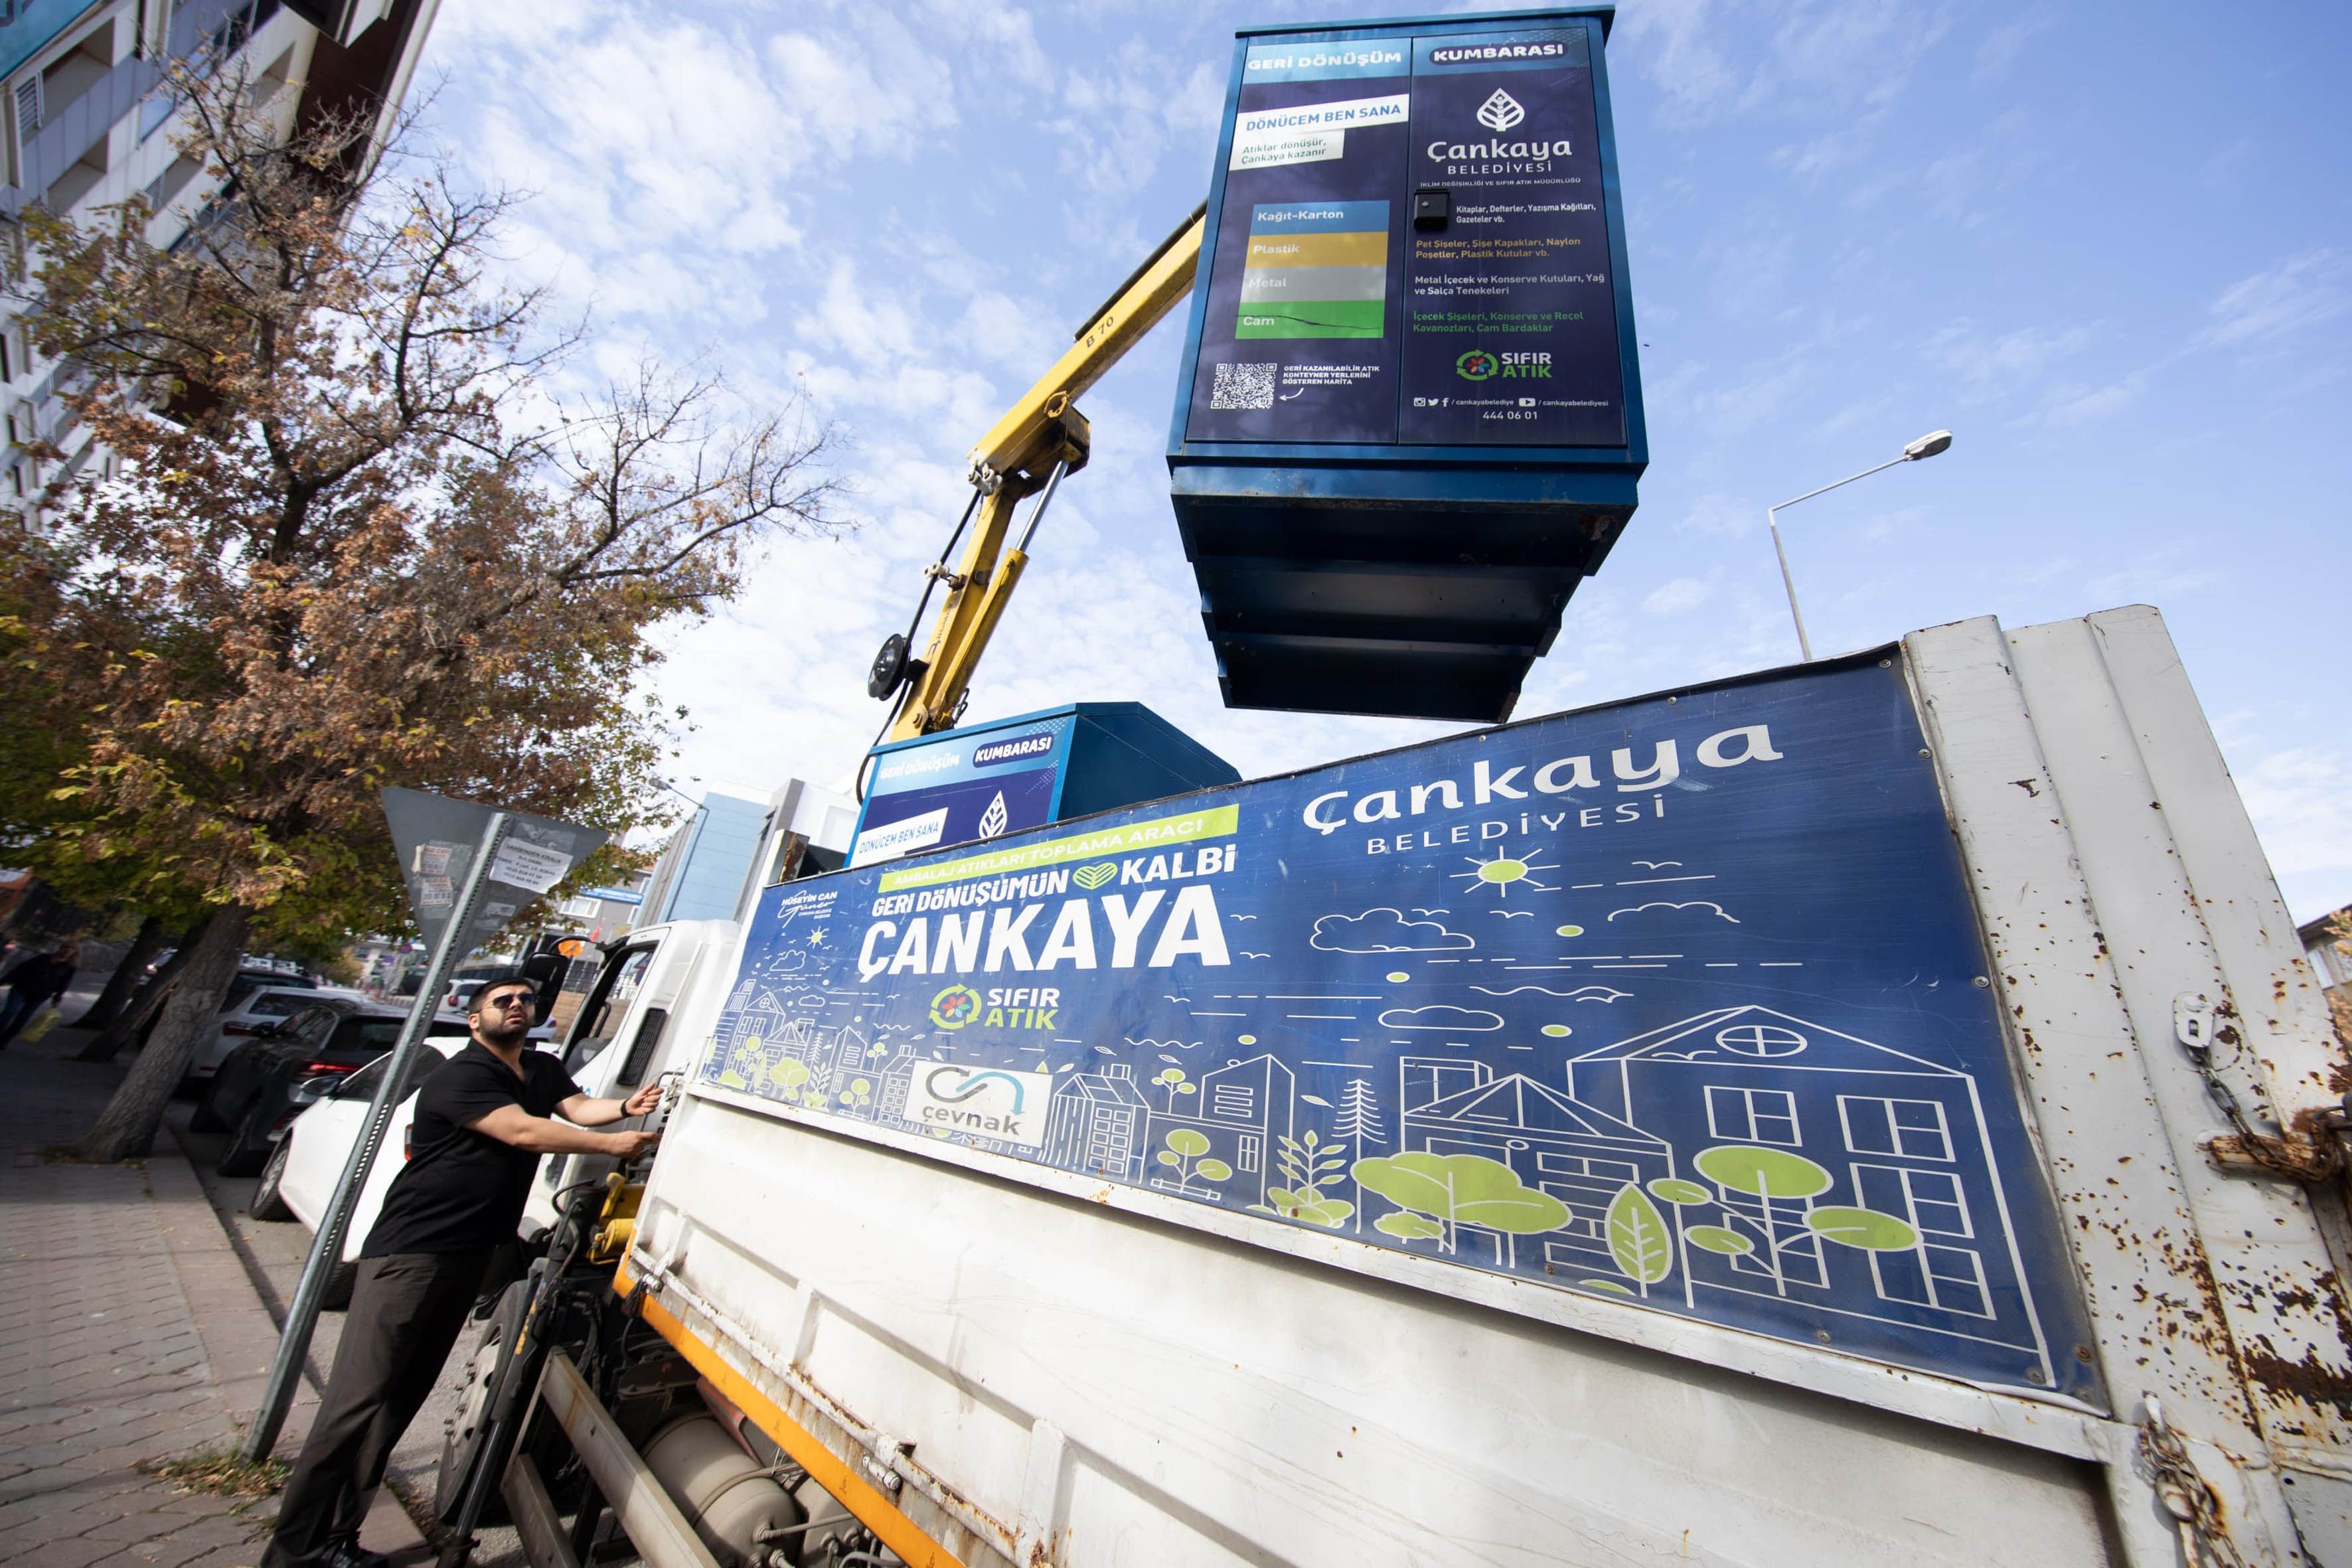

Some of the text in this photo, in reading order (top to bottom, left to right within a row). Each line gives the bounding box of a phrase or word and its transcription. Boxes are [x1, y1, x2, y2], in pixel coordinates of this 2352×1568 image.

[1248, 44, 1563, 70] GERİ DÖNÜŞÜM KUMBARASI
[1246, 104, 1401, 131] DÖNÜCEM BEN SANA
[1242, 141, 1278, 154] Atıklar
[1427, 139, 1573, 163] Çankaya
[1241, 147, 1327, 165] Çankaya kazanır
[1448, 161, 1551, 175] BELEDİYESİ
[1456, 202, 1596, 214] Kitaplar, Defterler, Yazışma Kağıtları,
[1258, 210, 1344, 222] Kağıt-Karton
[1253, 244, 1300, 255] Plastik
[1415, 237, 1581, 249] Pet Şişeler, Şişe Kapakları, Naylon
[1415, 250, 1459, 260] Poşetler,
[1460, 250, 1494, 258] Plastik
[1496, 249, 1533, 258] Kutular
[1247, 277, 1287, 289] Metal
[1415, 275, 1442, 284] Metal
[1444, 274, 1475, 285] İçecek
[1490, 275, 1537, 283] Konserve
[1539, 274, 1584, 283] Kutuları,
[1585, 274, 1605, 284] Yağ
[1427, 286, 1454, 295] Salça
[1456, 286, 1510, 295] Tenekeleri
[1243, 315, 1275, 326] Cam
[1413, 310, 1445, 321] İçecek
[1490, 311, 1538, 321] Konserve
[1554, 311, 1584, 321] Reçel
[1085, 315, 1115, 349] B 70
[1413, 323, 1554, 333] Kavanozları, Cam Bardaklar
[1501, 352, 1552, 364] SIFIR
[1502, 364, 1553, 378] ATIK
[1482, 411, 1539, 420] 444 06 01
[880, 737, 1052, 780] GERİ DÖNÜŞÜM KUMBARASI
[1302, 724, 1784, 836] Çankaya
[1368, 793, 1665, 856] BELEDİYESİ
[898, 827, 915, 843] BEN
[915, 822, 939, 838] SANA
[894, 819, 1204, 887] AMBALAJ ATIKLARI TOPLAMA ARACI
[871, 844, 1237, 917] GERİ DÖNÜŞÜMÜN KALBİ
[818, 891, 838, 902] CAN
[859, 884, 1232, 984] ÇANKAYA
[987, 987, 1061, 1008] SIFIR
[983, 1008, 1059, 1030] ATIK
[921, 1104, 1023, 1136] çevnak
